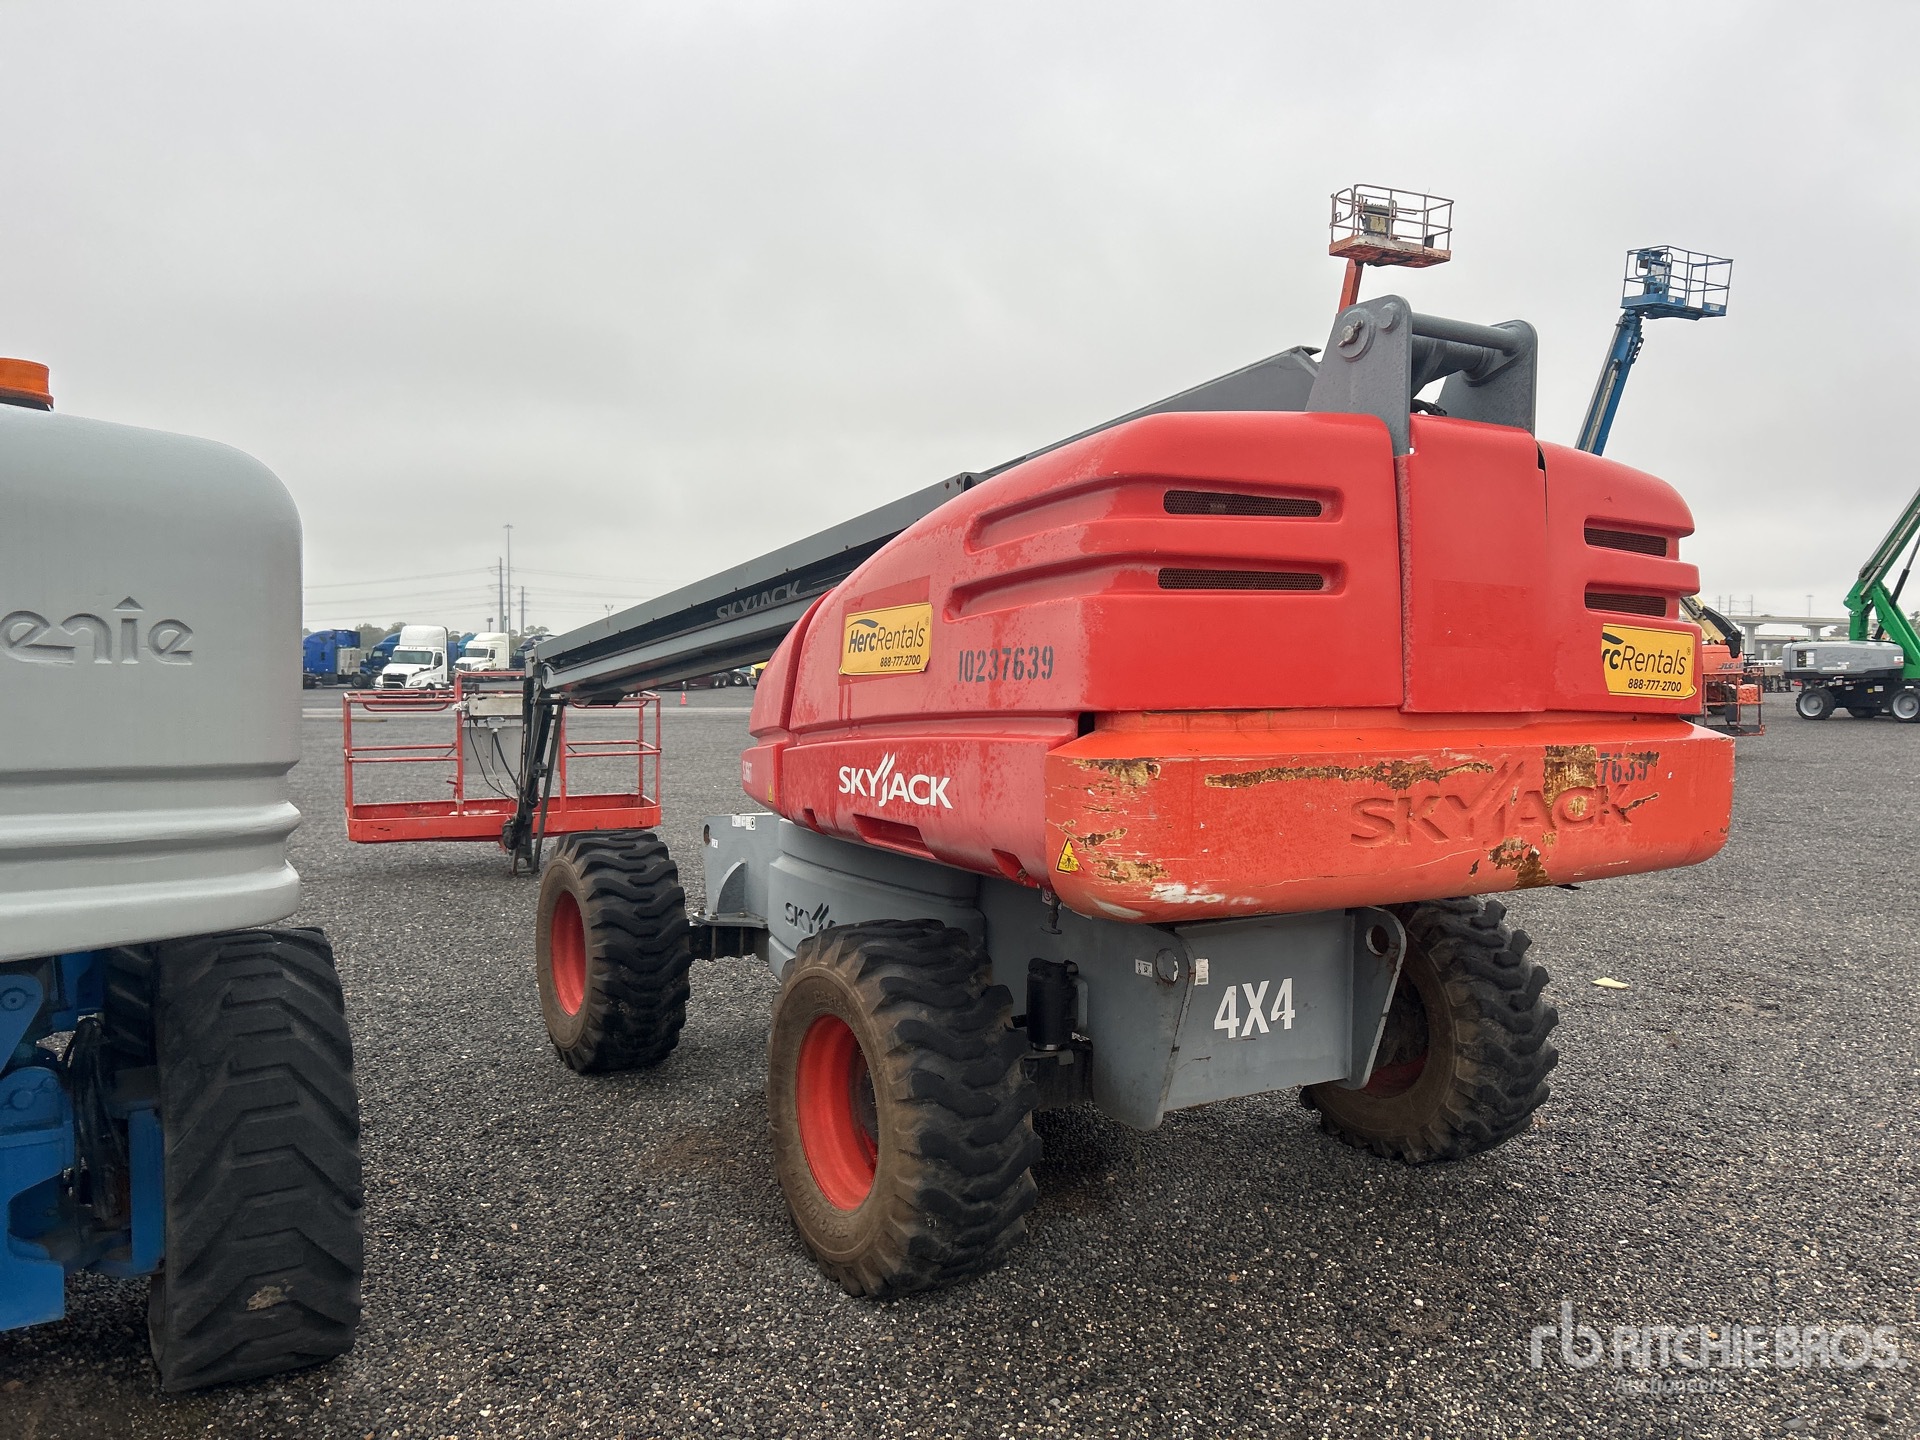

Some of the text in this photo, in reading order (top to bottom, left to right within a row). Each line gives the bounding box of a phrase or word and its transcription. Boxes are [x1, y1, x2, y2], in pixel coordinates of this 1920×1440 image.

[0, 596, 194, 666] enie
[848, 621, 925, 653] HercRentals
[880, 654, 921, 668] 888-777-2700
[958, 646, 1054, 682] 10237639
[1602, 645, 1687, 675] rcRentals
[1628, 678, 1682, 691] 888-777-2700
[839, 752, 953, 809] SKYJACK
[1350, 761, 1632, 849] SKYJACK
[1214, 977, 1296, 1039] 4X4
